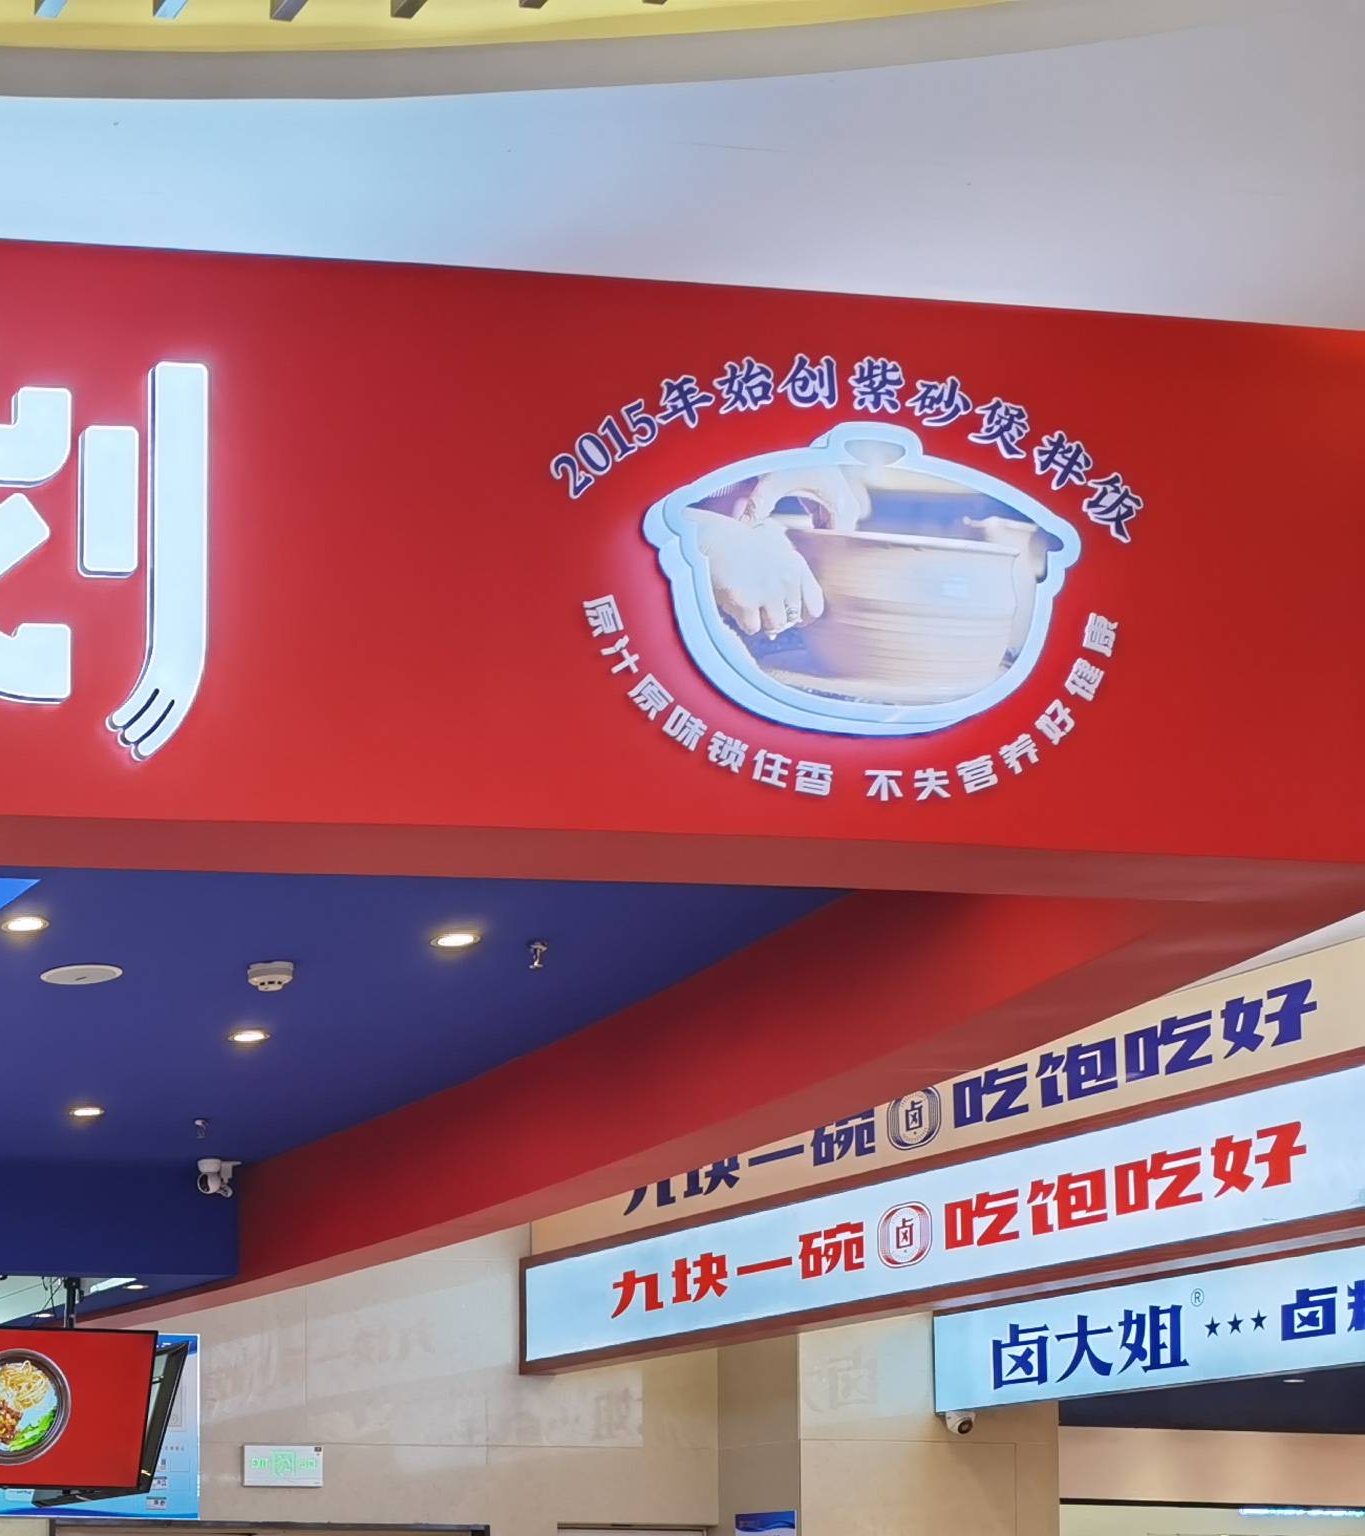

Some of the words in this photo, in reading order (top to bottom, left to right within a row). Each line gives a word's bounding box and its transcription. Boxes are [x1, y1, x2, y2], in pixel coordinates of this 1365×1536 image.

[549, 353, 1145, 545] 2015年始创紫砂煲拌饭
[582, 594, 834, 797] 原汁原味锁住香
[863, 612, 1121, 801] 不失营养好健康
[952, 979, 1318, 1130] 吃饱吃好
[610, 1221, 865, 1320] 九块一碗
[944, 1121, 1308, 1252] 吃饱吃好
[991, 1303, 1190, 1390] 卤大姐
